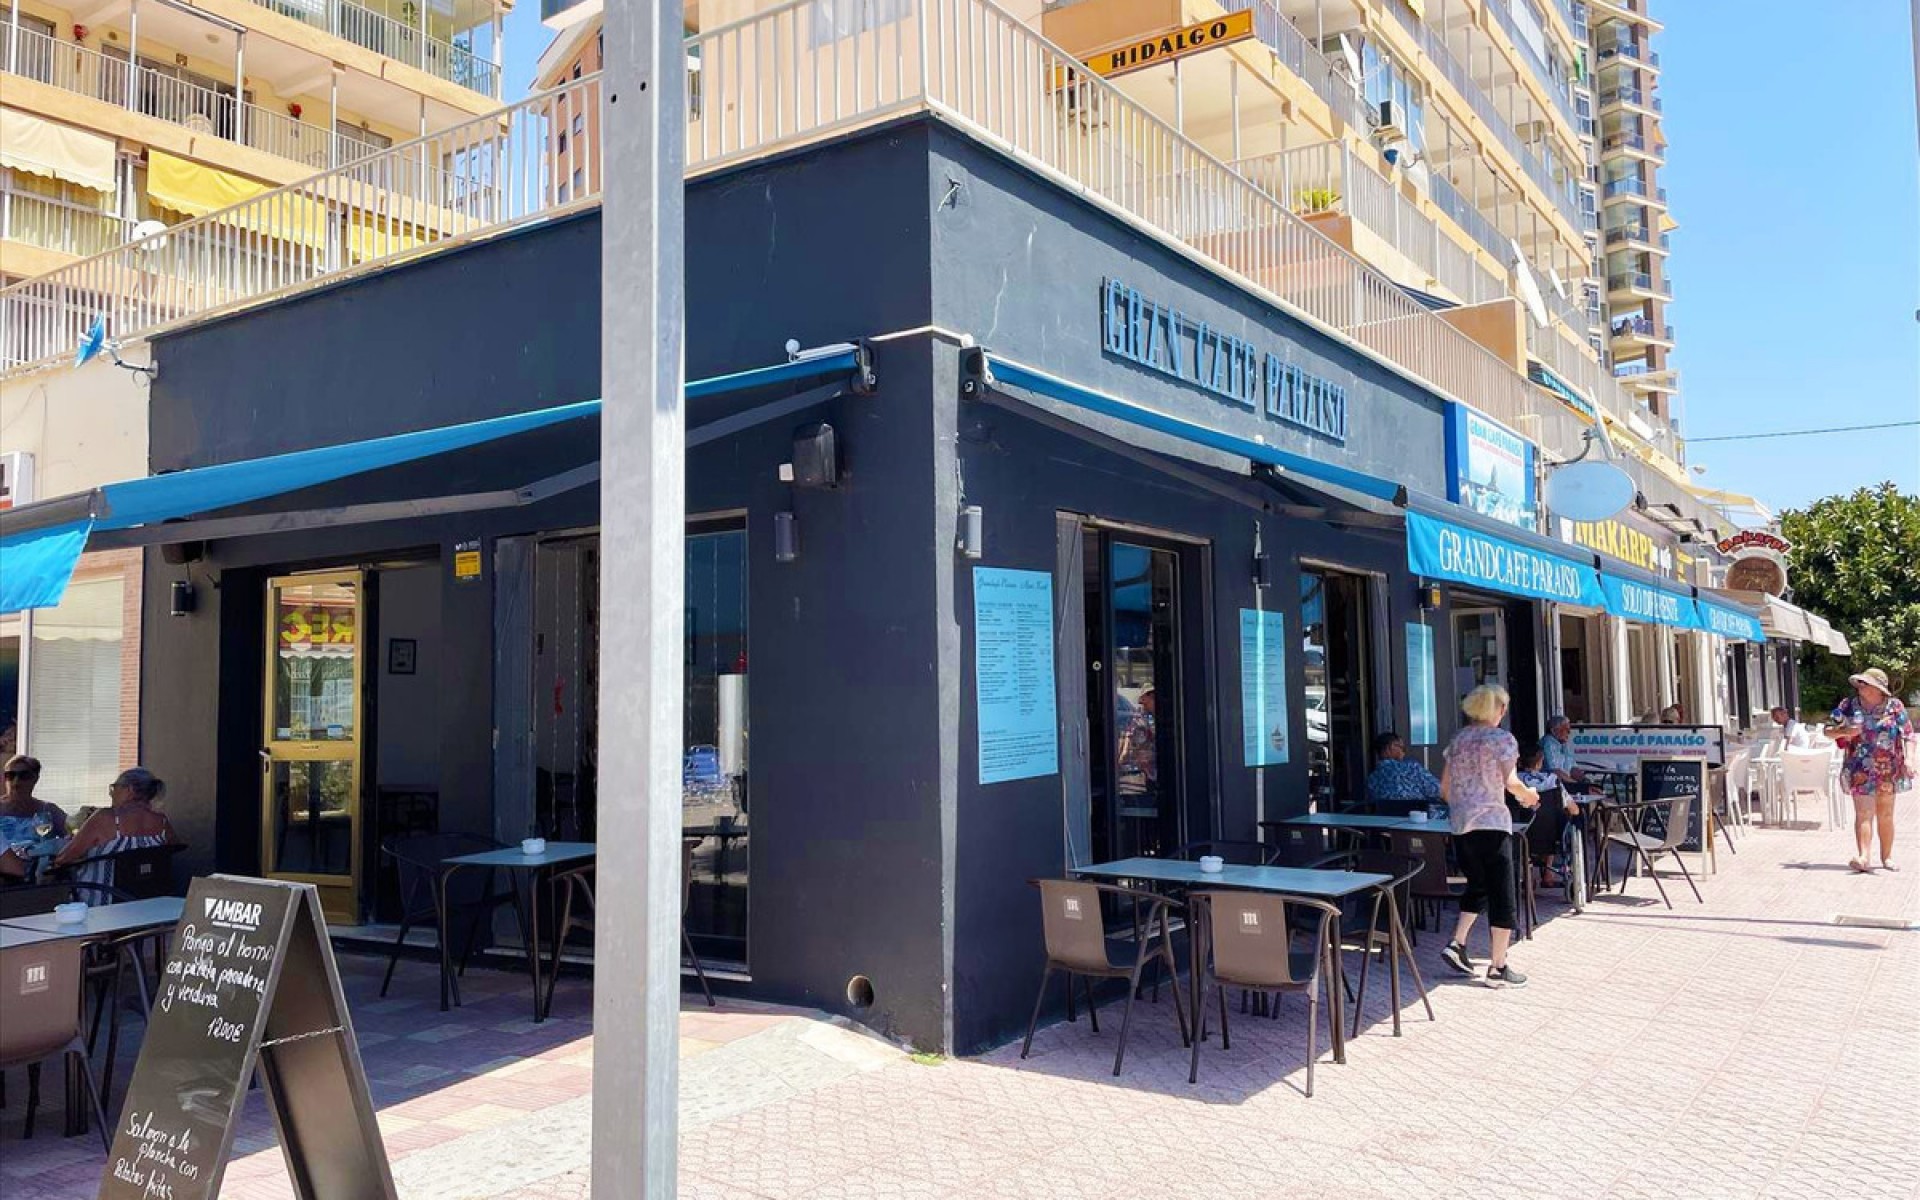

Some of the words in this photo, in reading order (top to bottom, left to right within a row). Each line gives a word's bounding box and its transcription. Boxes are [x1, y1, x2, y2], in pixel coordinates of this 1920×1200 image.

[1112, 22, 1227, 69] HIDALGO
[1106, 278, 1187, 380] GRAN
[1573, 735, 1609, 745] GRAN
[1612, 733, 1643, 745] CAFÉ
[1648, 733, 1706, 745] PARAÍSO
[210, 899, 262, 926] AMBAR
